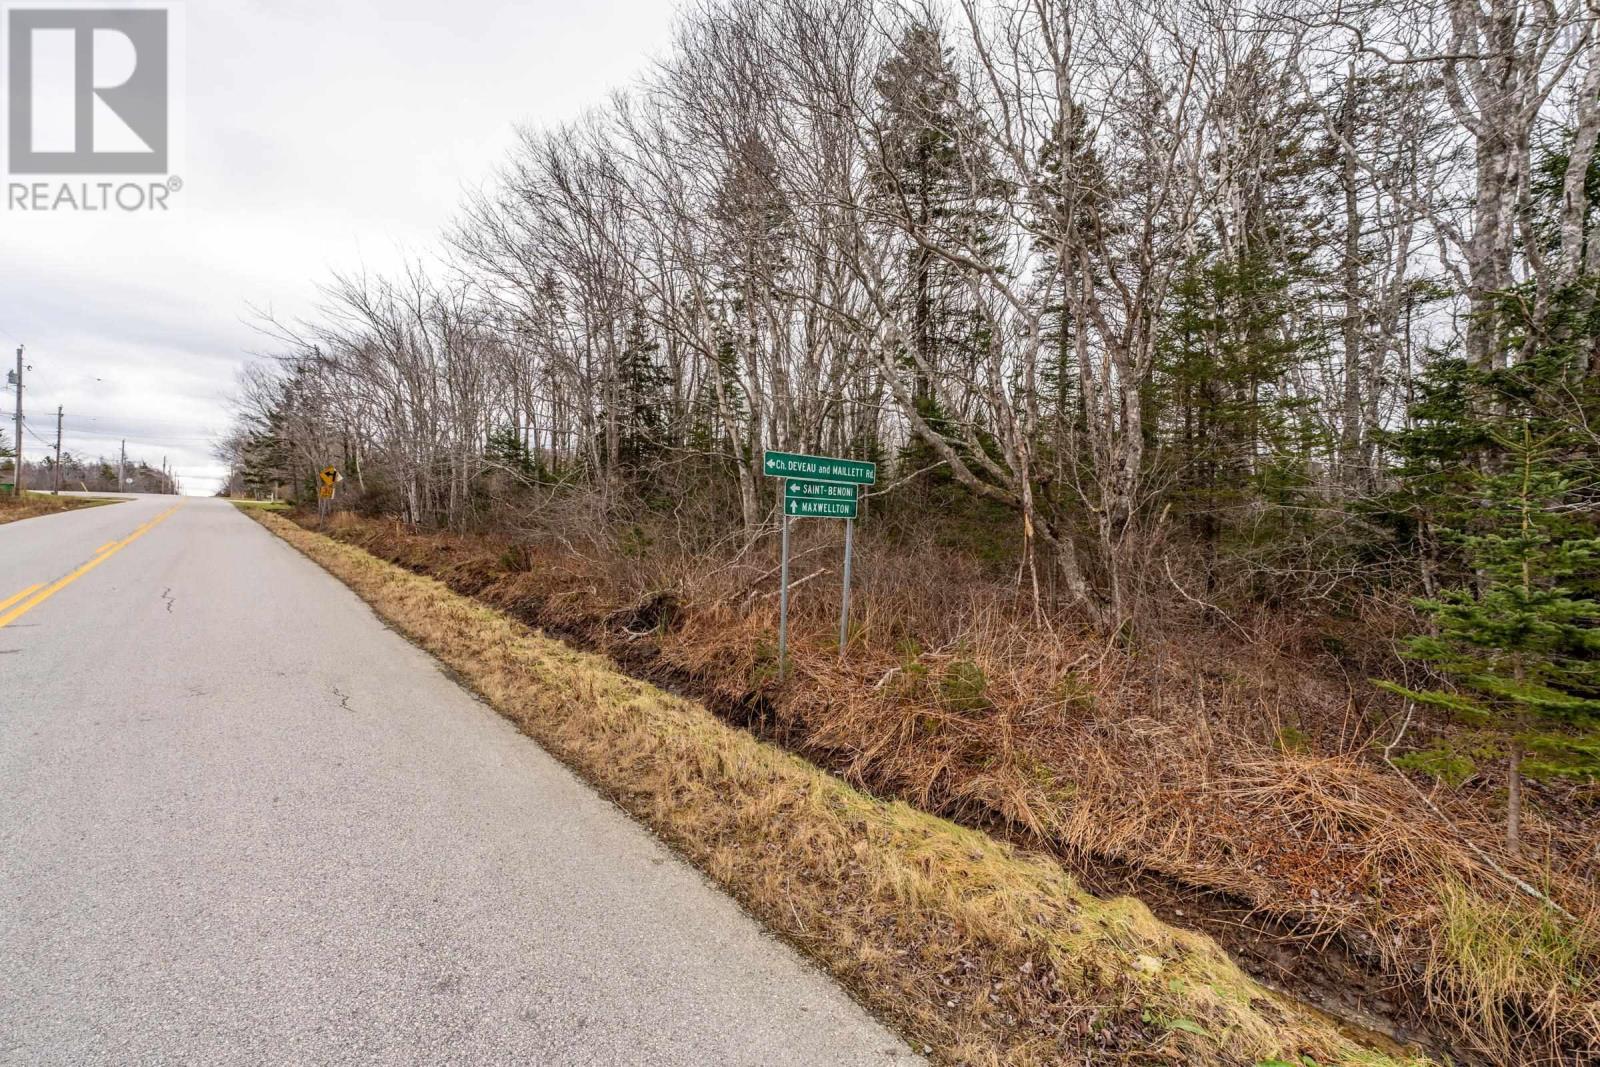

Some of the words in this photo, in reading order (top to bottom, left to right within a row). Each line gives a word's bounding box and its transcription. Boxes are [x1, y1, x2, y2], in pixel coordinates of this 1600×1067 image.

[775, 459, 787, 470] Ch.
[788, 460, 816, 473] DEVEAU
[818, 465, 831, 474] and
[832, 467, 864, 477] MAILLETT
[865, 469, 874, 479] Rd
[802, 484, 853, 497] SAINT-BENONI
[801, 502, 850, 514] MAXWELLTON
